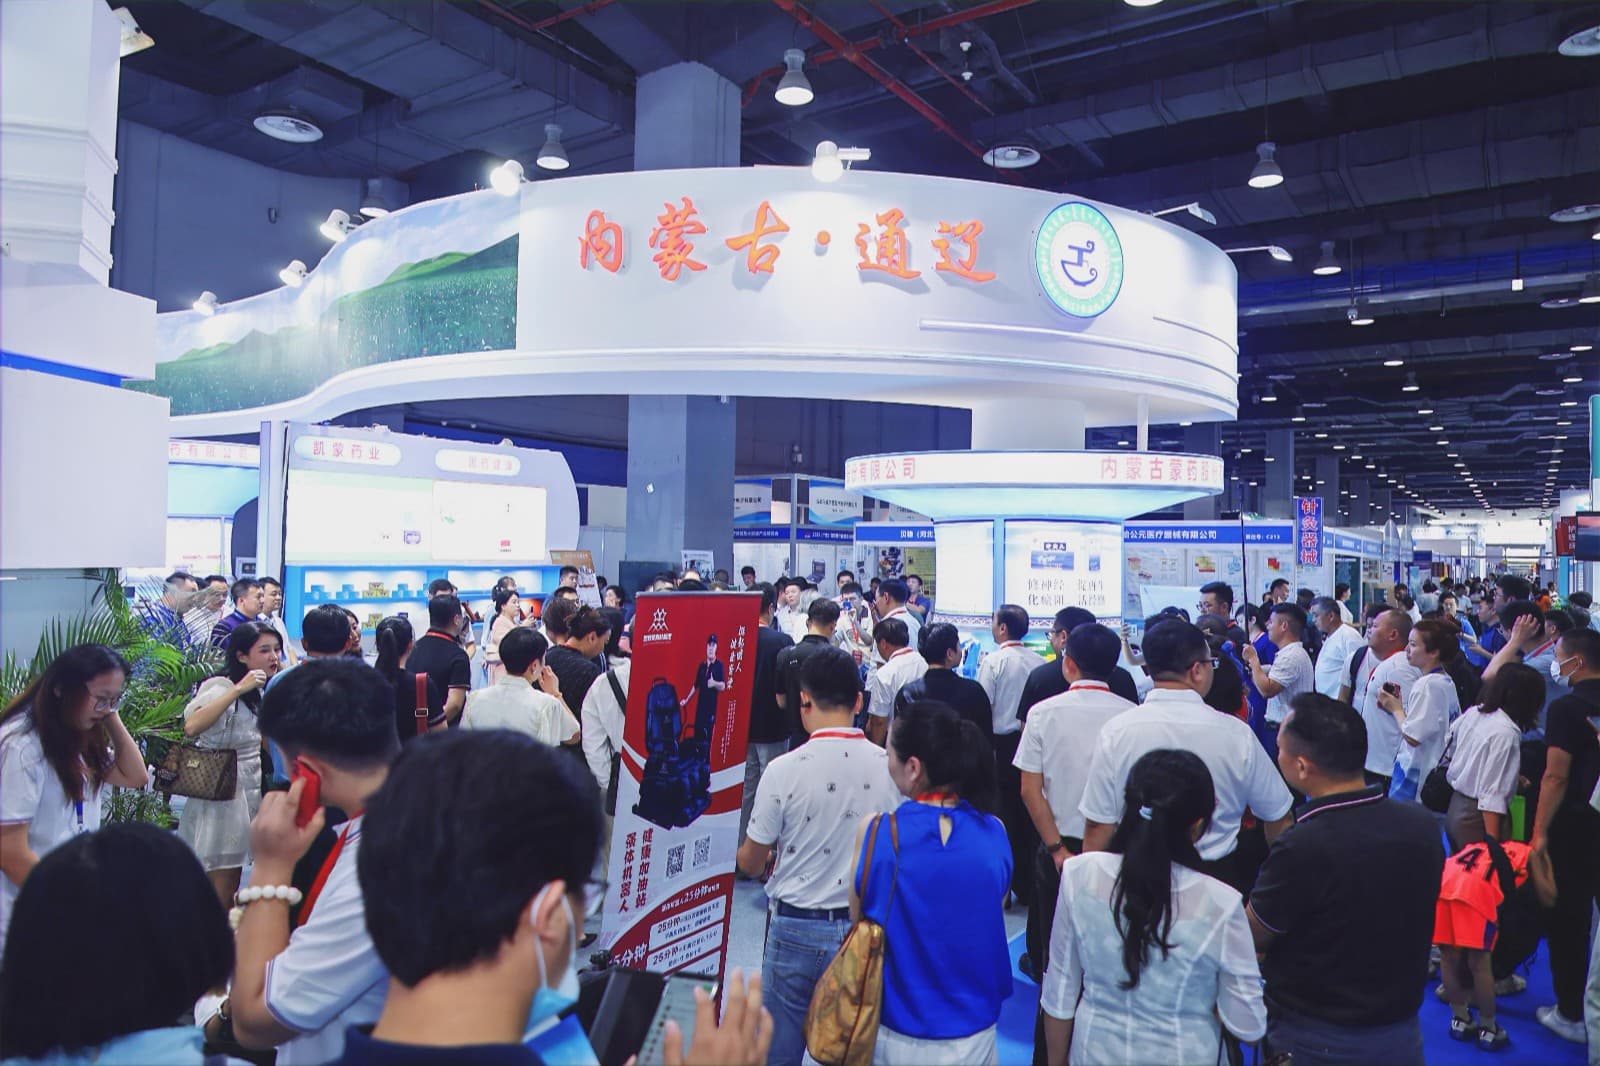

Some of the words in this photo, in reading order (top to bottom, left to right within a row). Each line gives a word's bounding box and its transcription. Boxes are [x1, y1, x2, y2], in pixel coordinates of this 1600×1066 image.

[577, 196, 997, 282] 内蒙古·通辽
[1300, 497, 1320, 566] 针灸器械
